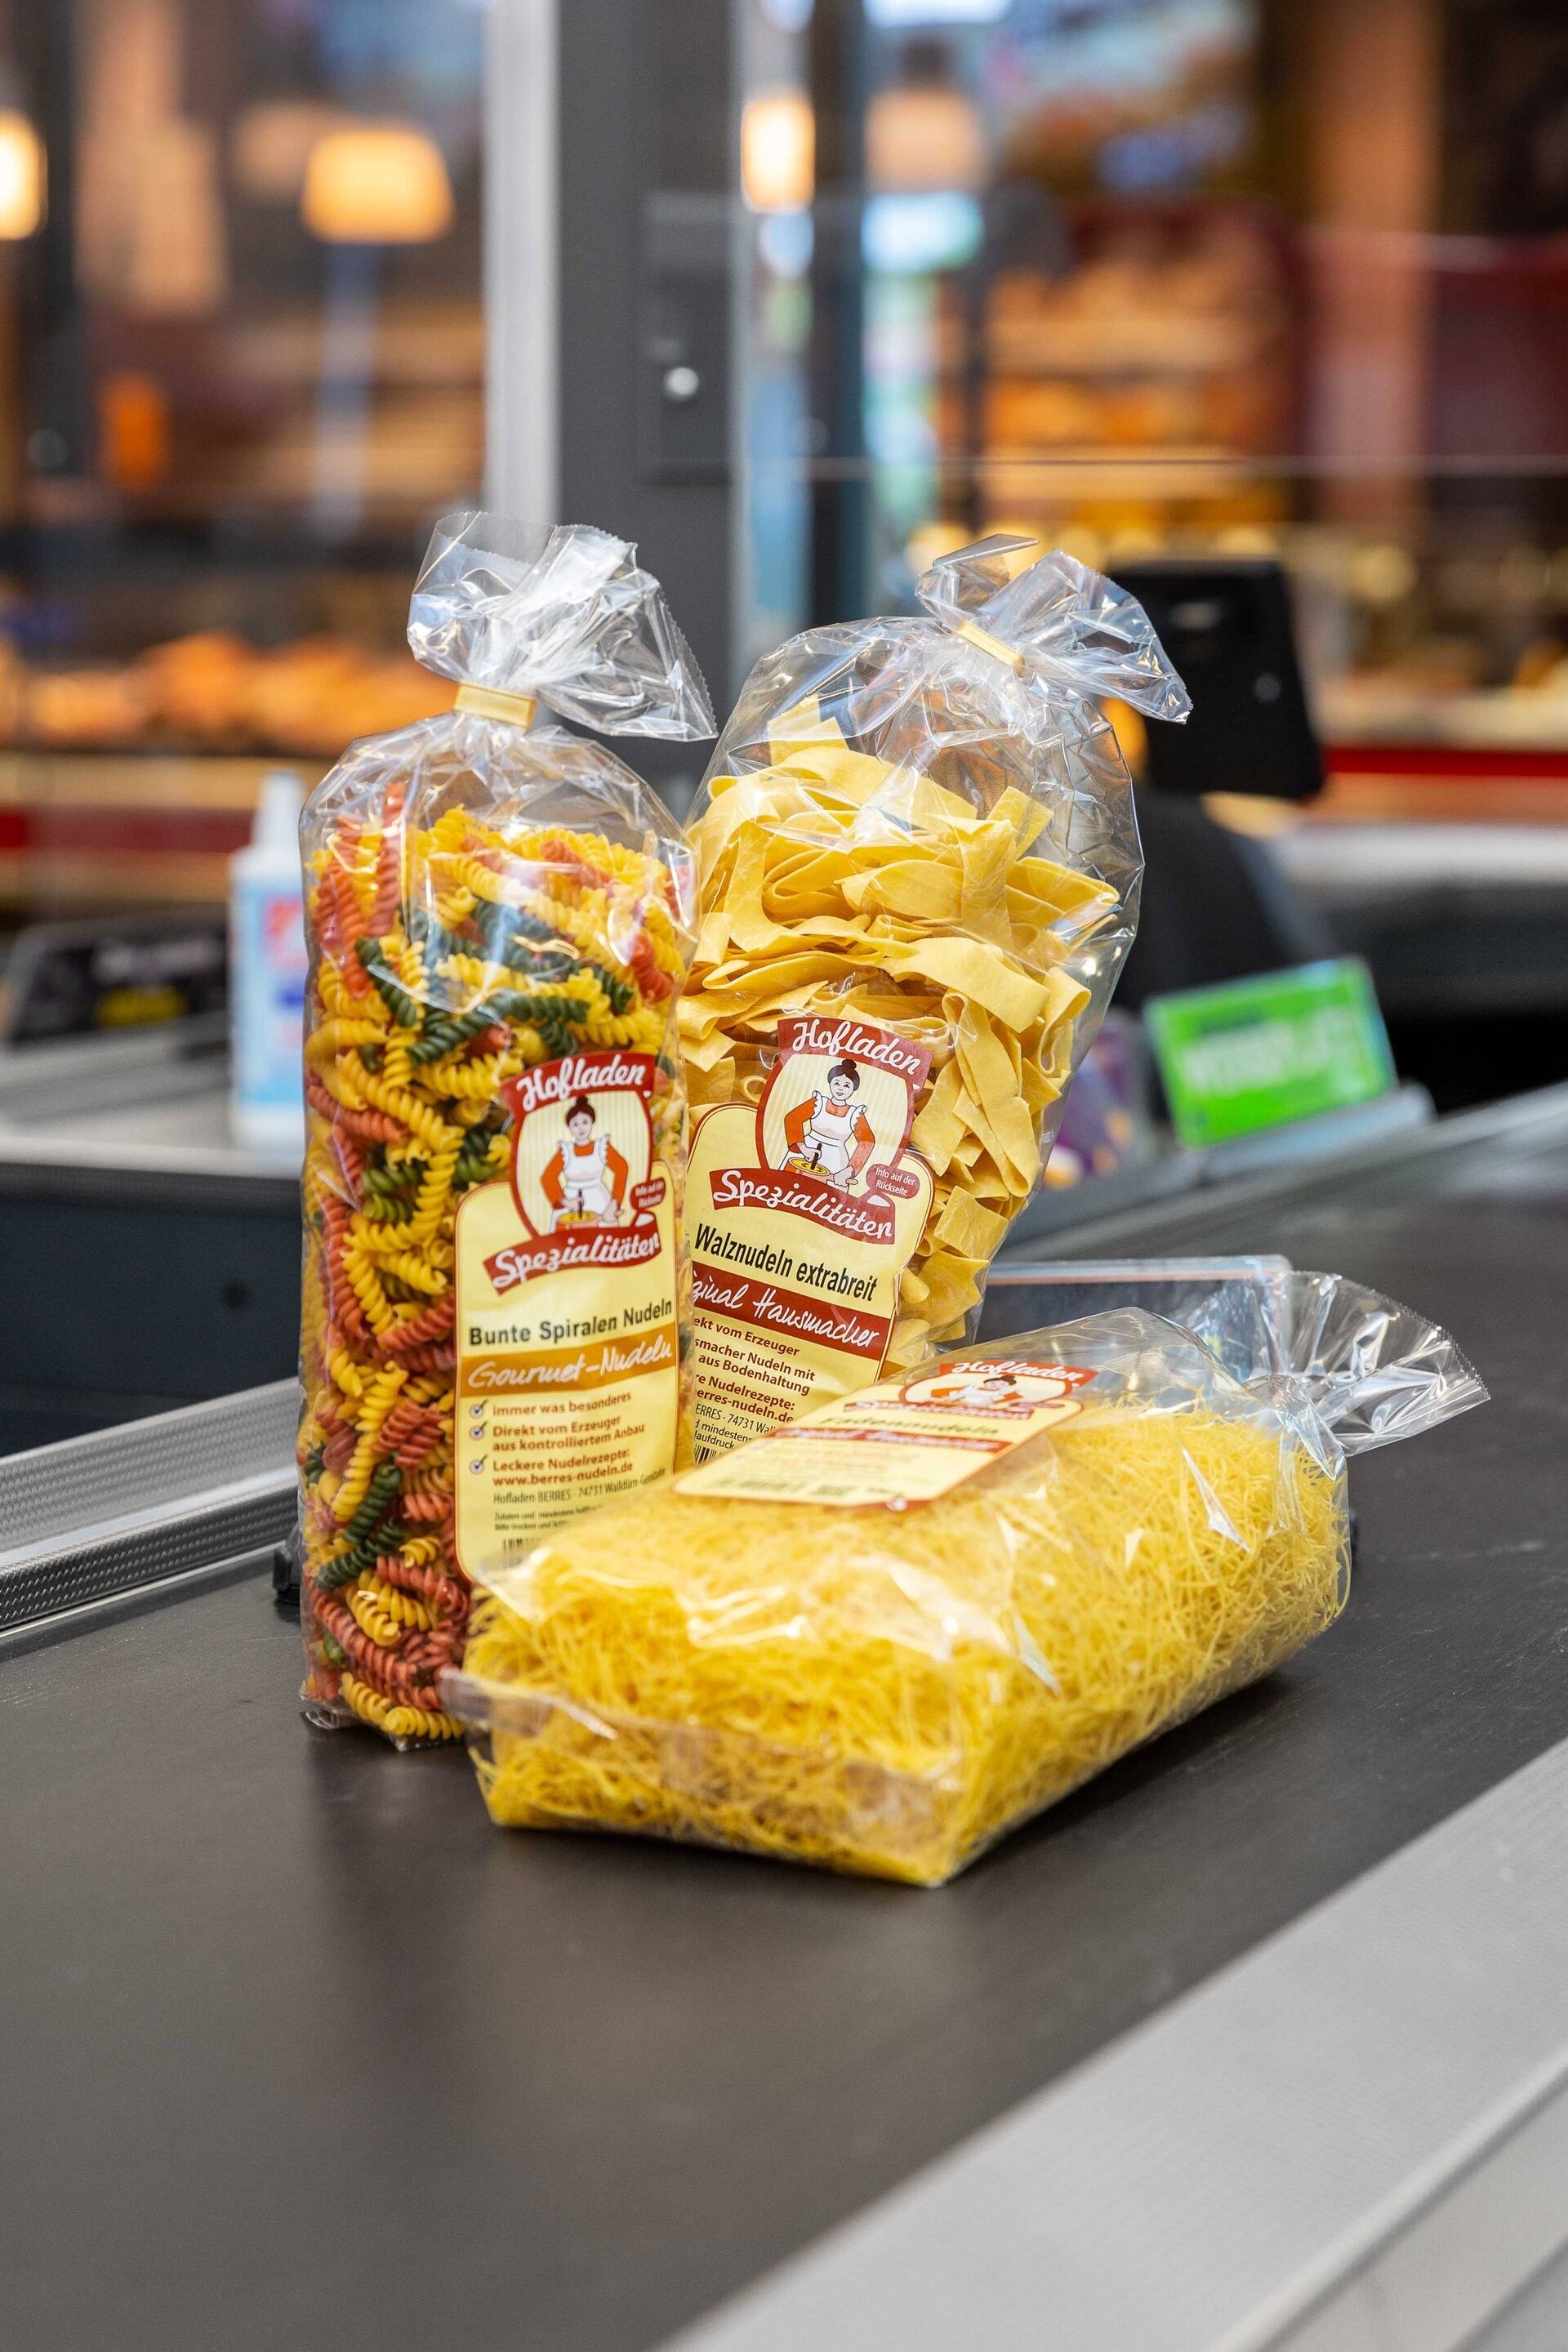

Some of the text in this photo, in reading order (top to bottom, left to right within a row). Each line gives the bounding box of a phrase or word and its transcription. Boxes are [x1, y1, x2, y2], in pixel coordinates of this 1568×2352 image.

[792, 1018, 922, 1076] Hofladen
[516, 1054, 646, 1111] Hofladen
[875, 1167, 915, 1186] Info auf der
[875, 1179, 908, 1196] Rückseite
[713, 1170, 893, 1240] Spezialitäten
[492, 1232, 661, 1288] Spezialitäten
[694, 1223, 879, 1302] Walznudeln extrabreit
[470, 1298, 672, 1346] Bunte Spiralen Nudeln
[693, 1270, 880, 1348] ginal Hausmacher
[694, 1316, 800, 1356] ekt vom Erzeuger
[468, 1334, 674, 1388] Gourmet-Nudeln
[695, 1338, 817, 1382] smacher Nudeln mit
[698, 1354, 720, 1368] aus
[722, 1359, 811, 1396] Bodenhaltung
[951, 1361, 1085, 1382] Hofladen
[492, 1392, 632, 1417] immer was besonderes
[696, 1389, 794, 1423] erres-nudeln.de
[708, 1376, 795, 1410] Nudelrezepte:
[492, 1415, 621, 1437] Direkt vom Erzeuger
[696, 1403, 723, 1421] ERRES
[728, 1413, 754, 1431] 74731
[755, 1421, 776, 1434] Wal
[492, 1424, 645, 1451] aus kontrolliertem Anbau
[492, 1449, 630, 1472] Leckere Nudelrezepte:
[492, 1462, 634, 1486] www.berres-nudeln.de
[493, 1492, 536, 1504] Hofladen
[537, 1489, 572, 1502] BERRES
[577, 1484, 604, 1498] 74731
